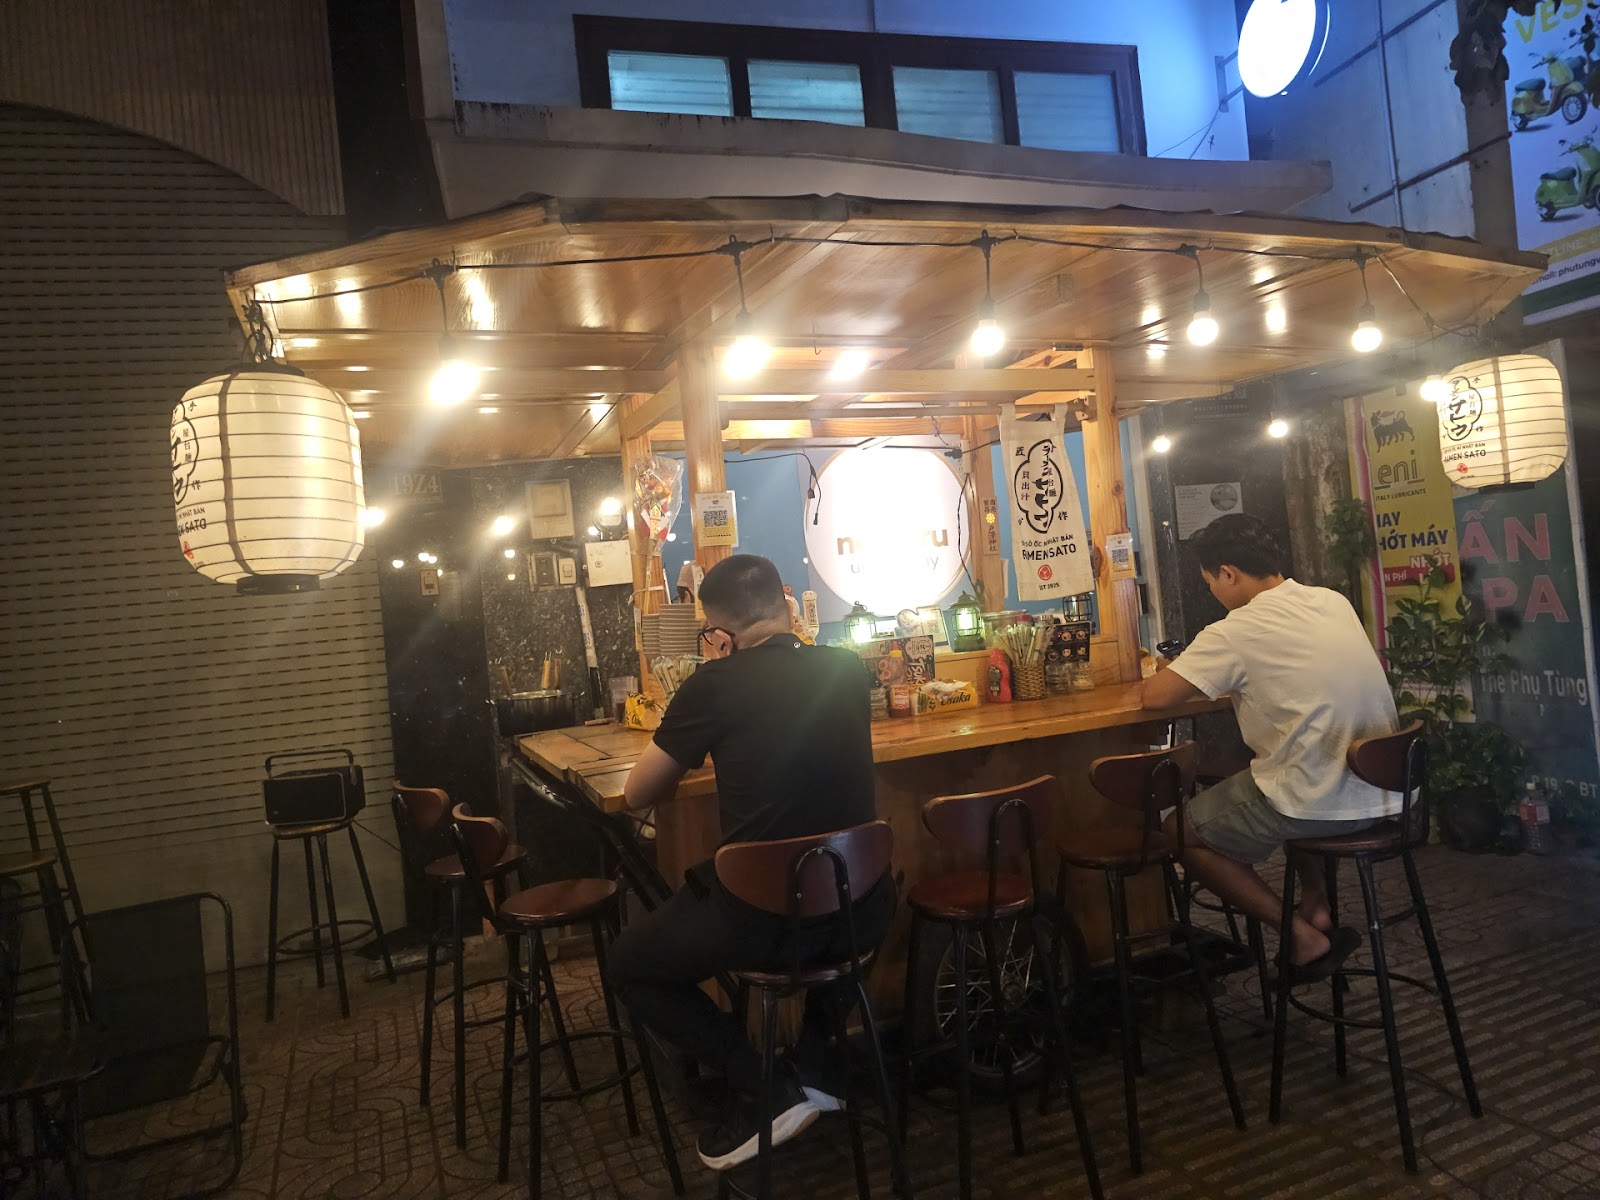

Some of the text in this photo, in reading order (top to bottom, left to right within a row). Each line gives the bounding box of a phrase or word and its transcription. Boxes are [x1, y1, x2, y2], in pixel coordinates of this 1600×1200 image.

[1514, 0, 1594, 43] VES
[1377, 449, 1419, 485] eni
[184, 518, 207, 534] SATO
[1411, 523, 1449, 548] MÁY
[1543, 669, 1588, 706] Tùng
